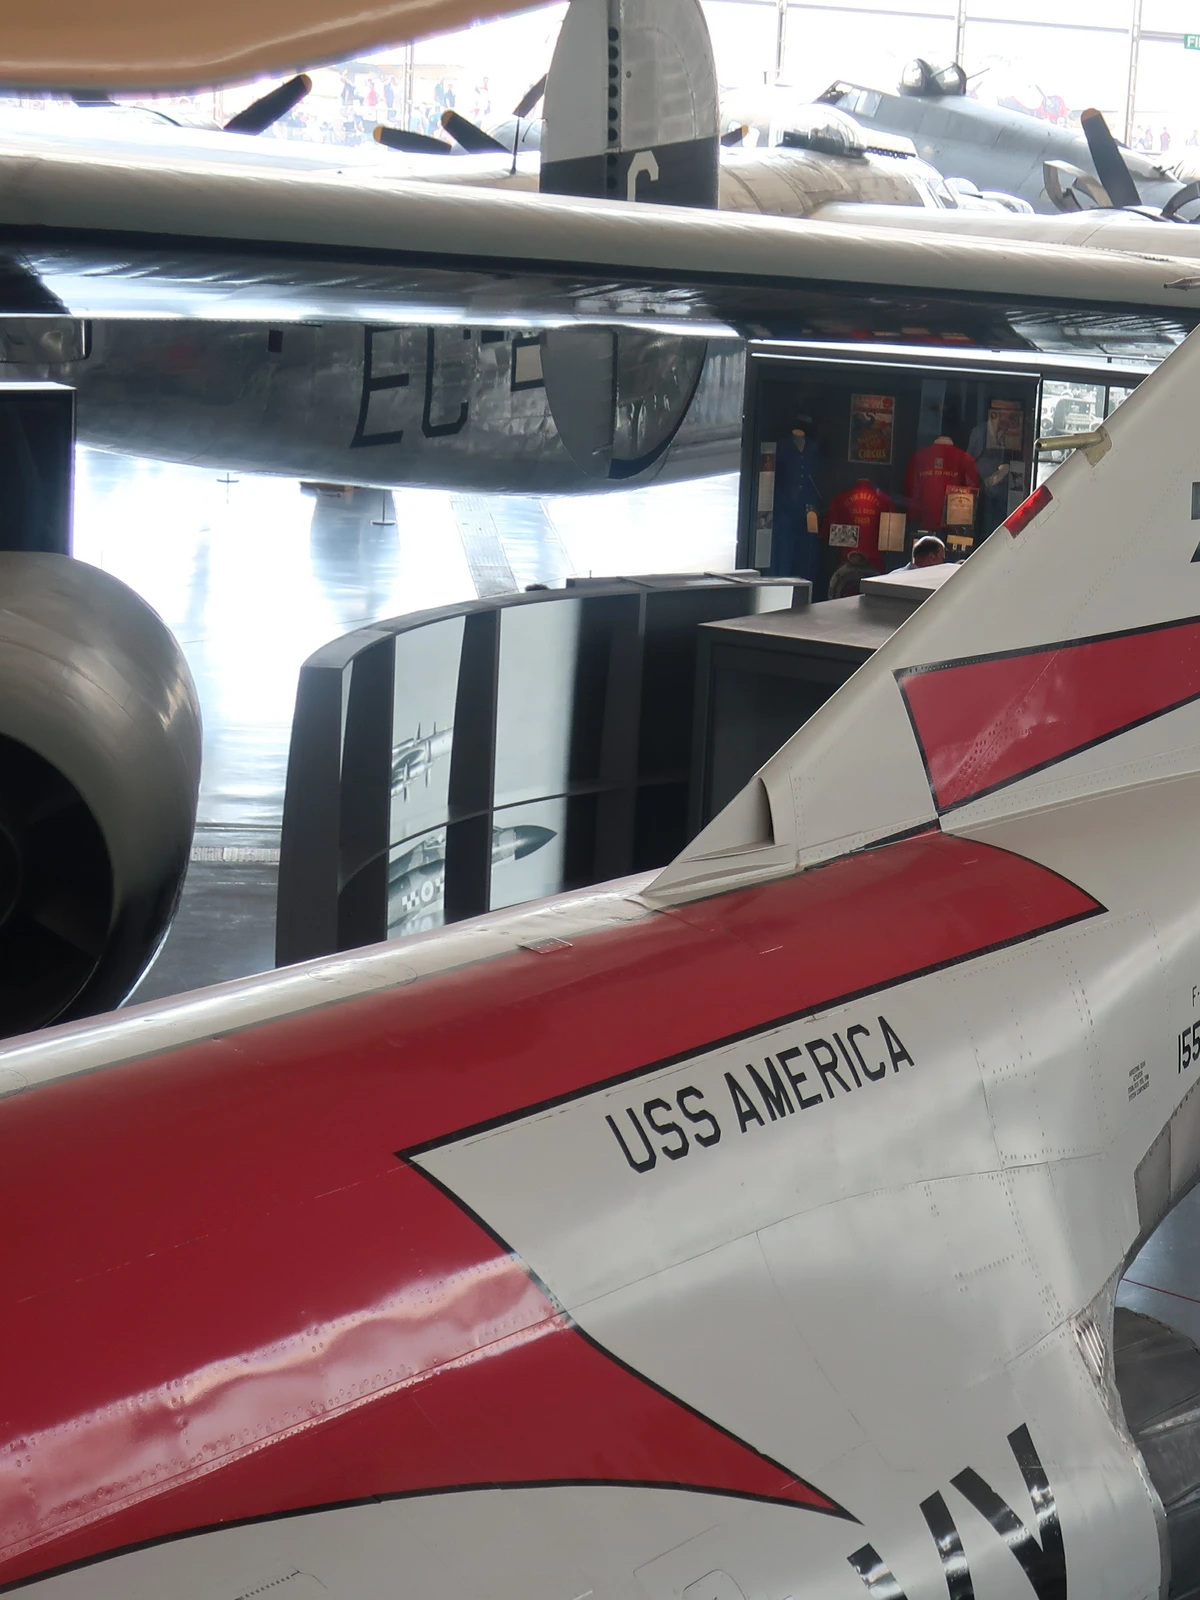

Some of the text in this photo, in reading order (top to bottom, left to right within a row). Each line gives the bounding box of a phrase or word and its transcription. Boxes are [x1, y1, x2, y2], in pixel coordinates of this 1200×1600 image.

[858, 448, 886, 459] CIRCUS
[605, 1016, 915, 1174] USS AMERICA
